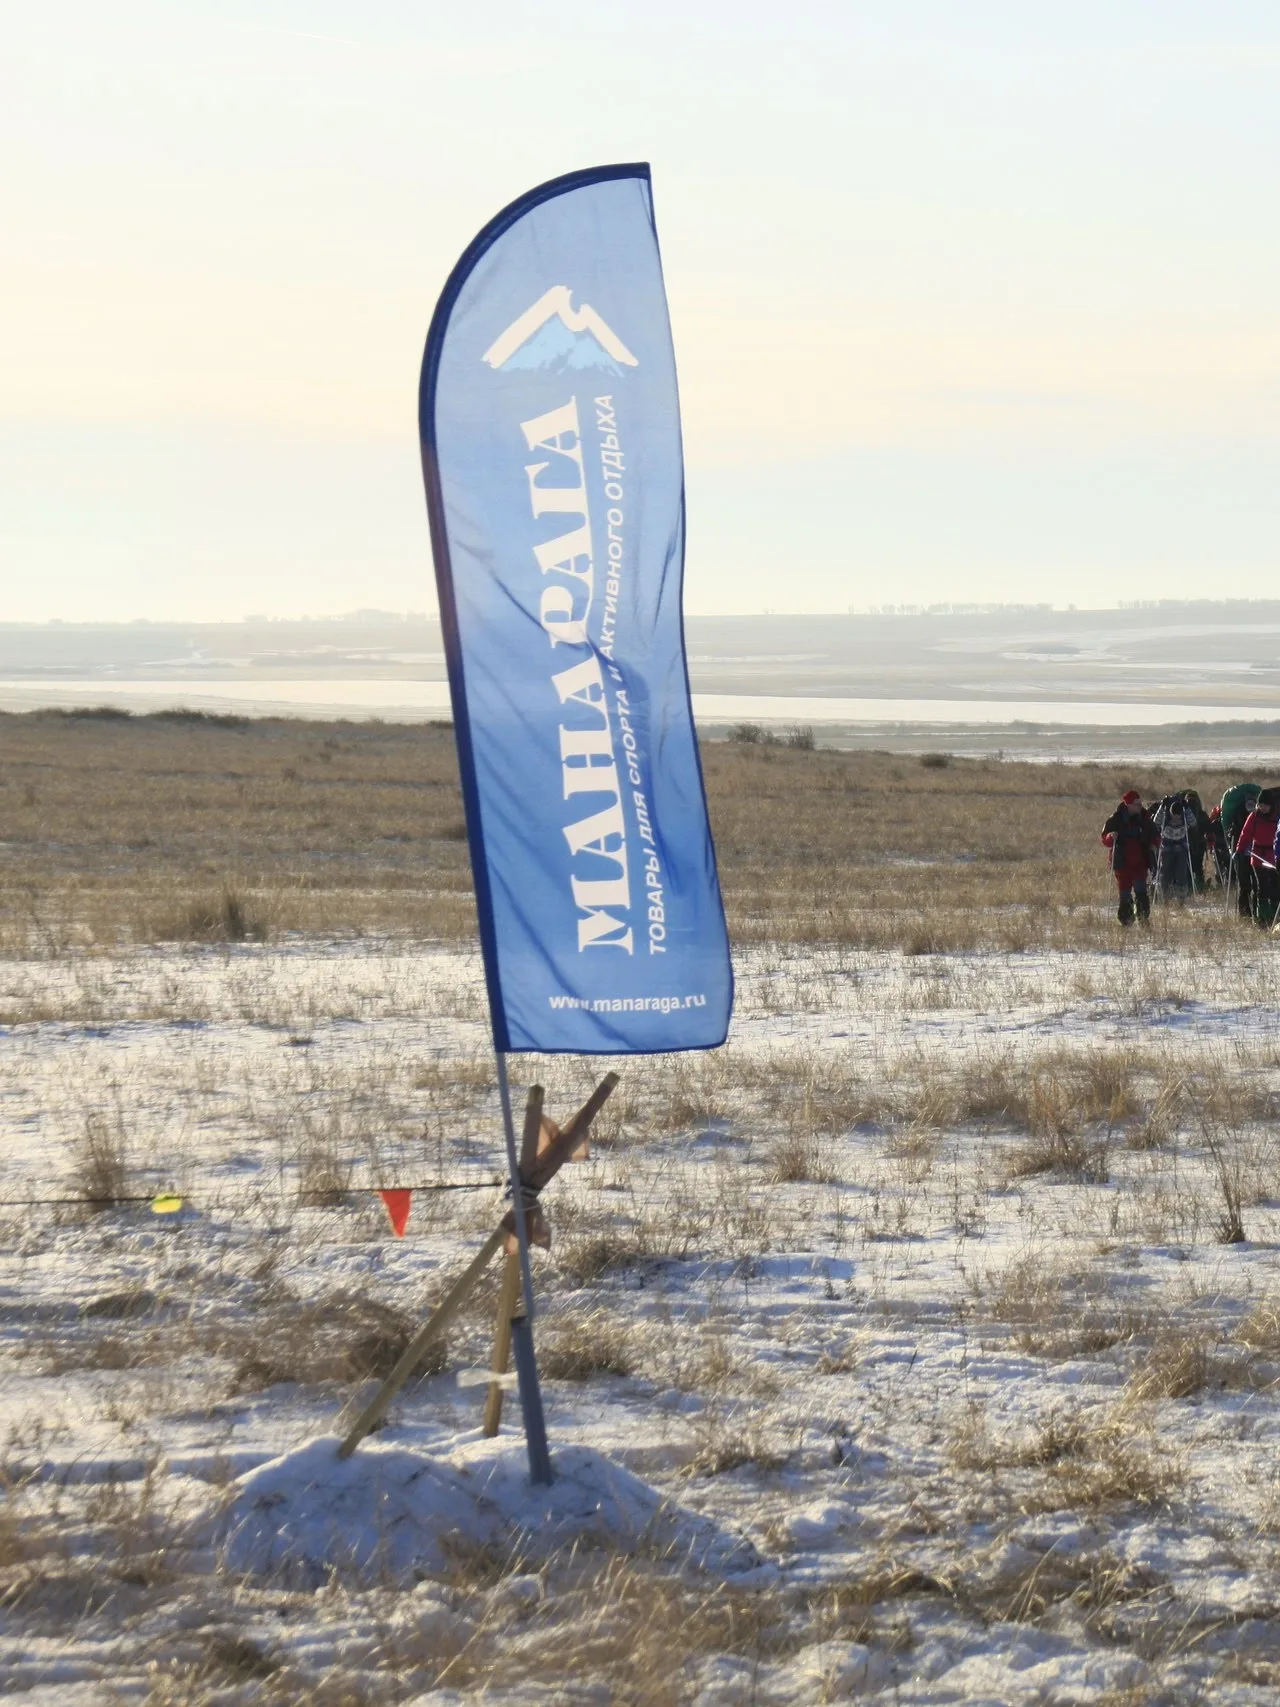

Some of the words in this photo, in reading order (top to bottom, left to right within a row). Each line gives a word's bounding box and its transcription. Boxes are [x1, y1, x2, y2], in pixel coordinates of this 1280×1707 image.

[594, 395, 626, 500] ОТДЫХА
[599, 508, 624, 661] АКТИВНОГО
[519, 394, 634, 956] МАНАРАГА
[616, 689, 641, 785] СПОРТА
[633, 791, 656, 846] ДЛЯ
[643, 848, 667, 955] ТОВАРЫ
